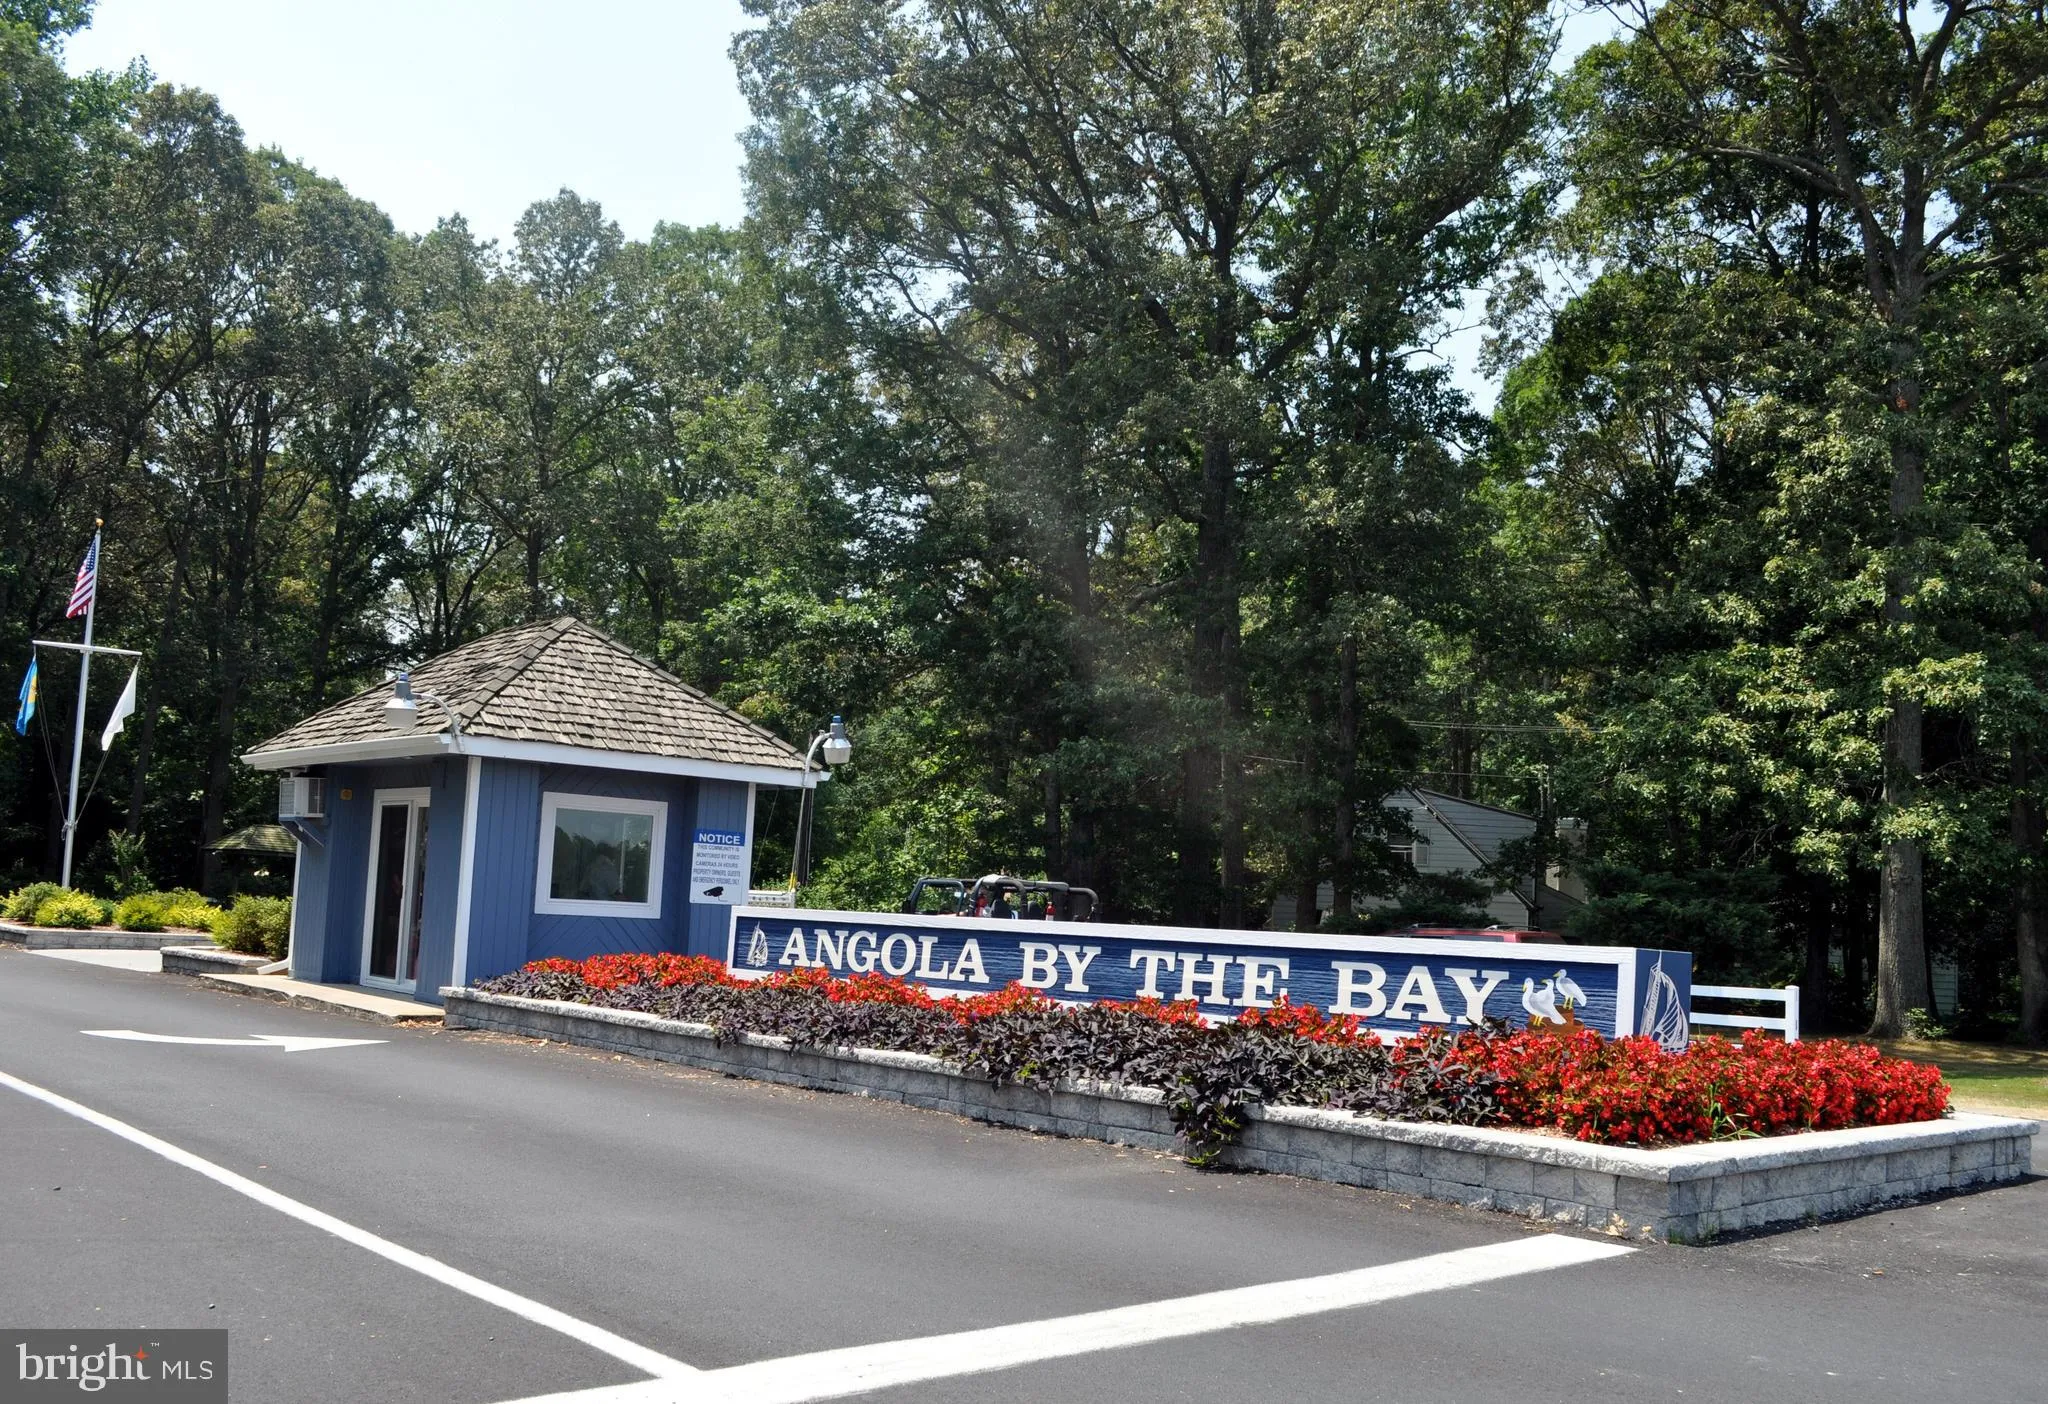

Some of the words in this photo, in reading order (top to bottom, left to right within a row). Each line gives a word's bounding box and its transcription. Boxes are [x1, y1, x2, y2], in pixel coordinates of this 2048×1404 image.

[699, 833, 740, 844] NOTICE
[778, 927, 990, 984] ANGOLA
[1019, 941, 1102, 993] BY
[1130, 948, 1290, 1008] THE
[1328, 960, 1510, 1024] BAY
